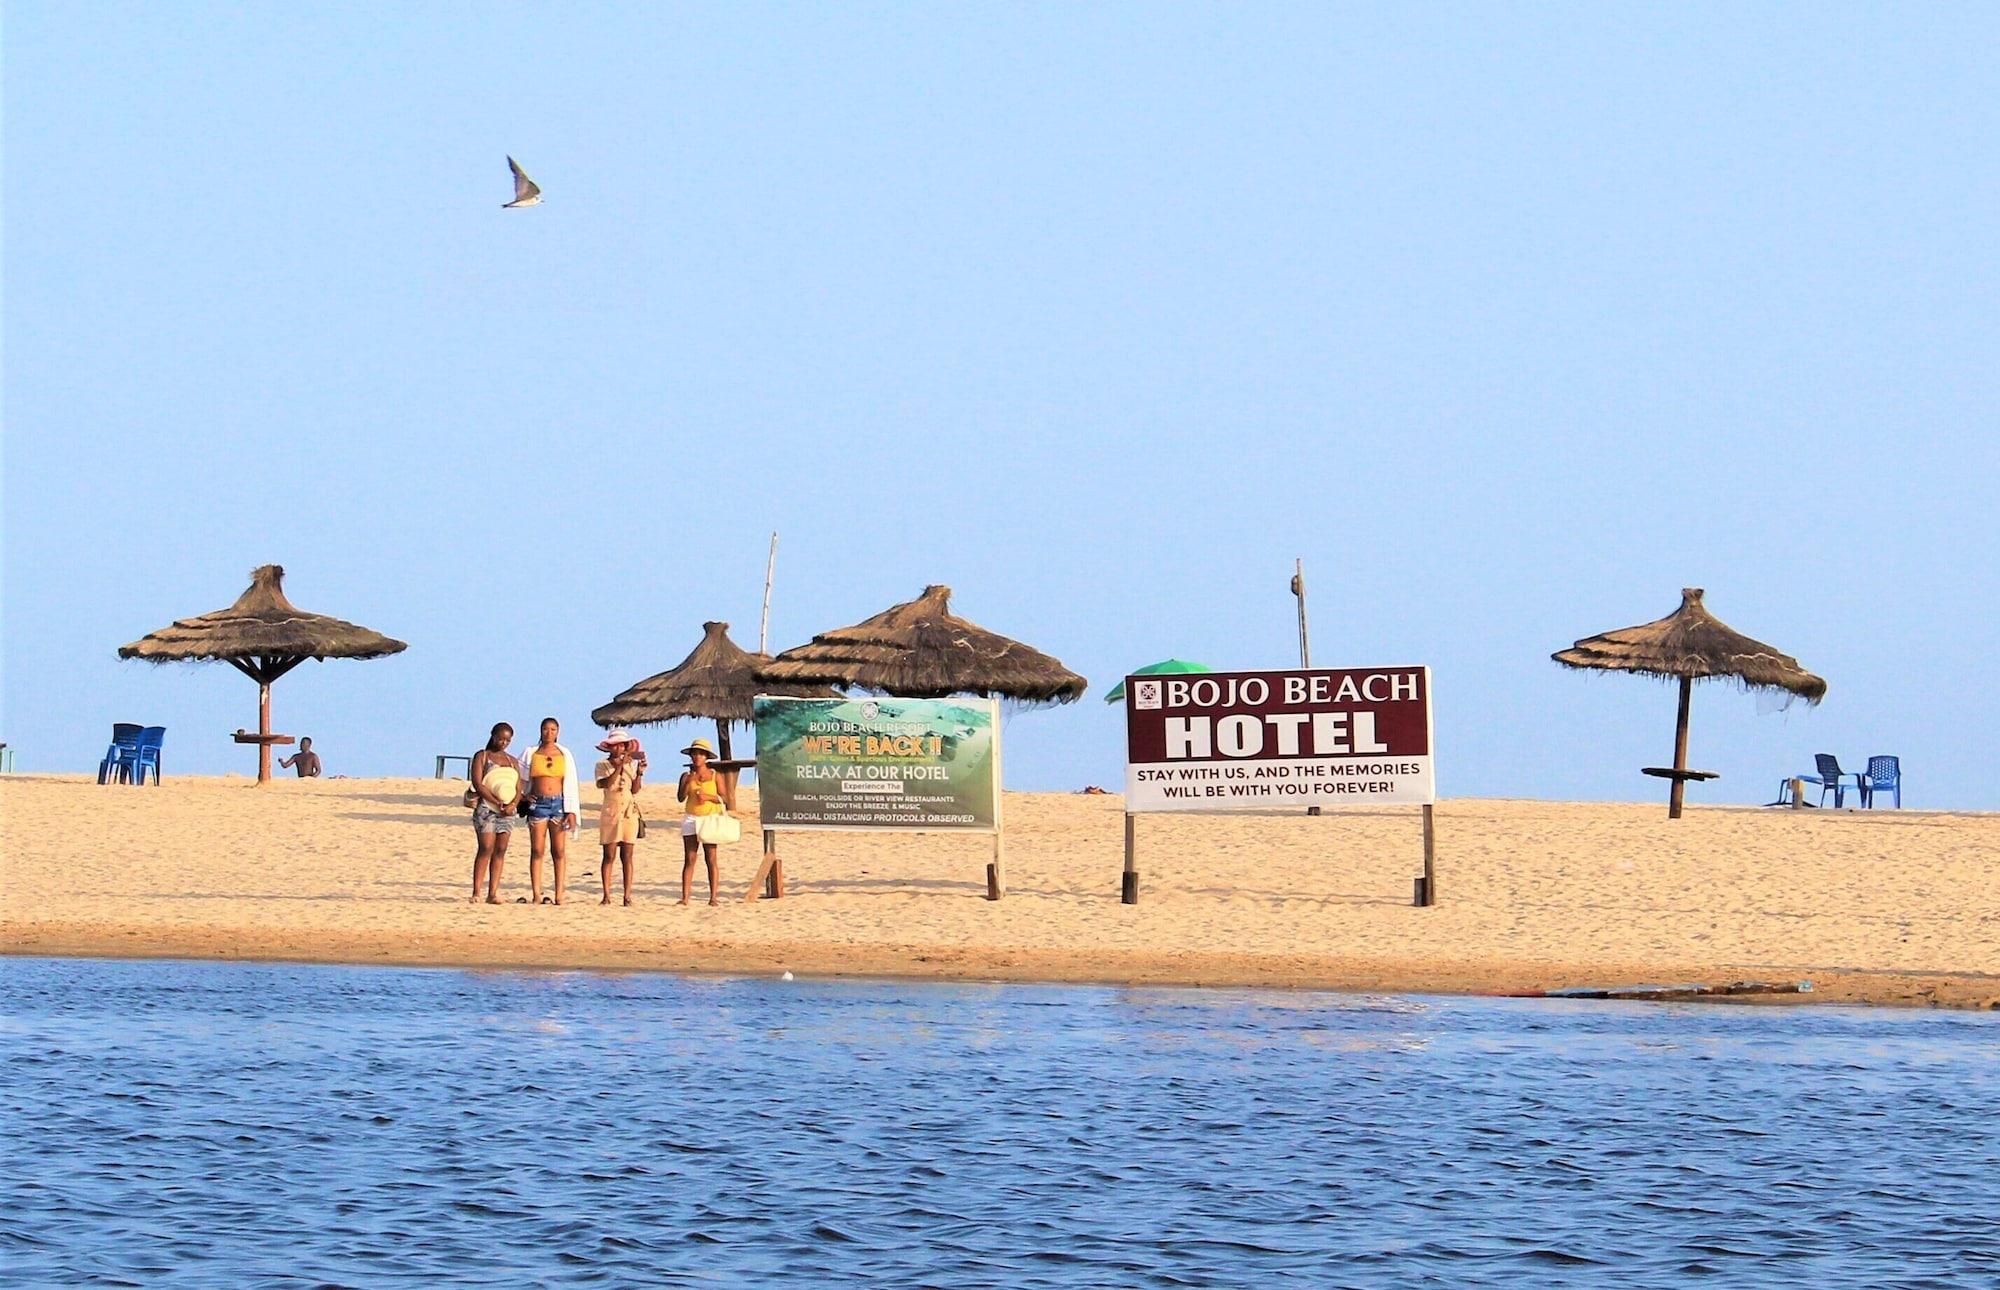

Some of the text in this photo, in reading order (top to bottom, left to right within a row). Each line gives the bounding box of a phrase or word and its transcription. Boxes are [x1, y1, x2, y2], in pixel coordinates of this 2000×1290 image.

[1167, 673, 1419, 708] BOJO BEACH
[809, 722, 840, 733] BOJO
[843, 722, 882, 733] BEACH
[1165, 711, 1388, 759] HOTEL
[802, 735, 862, 756] WE'RE
[866, 735, 926, 757] BACK
[796, 765, 949, 780] RELAX AT OUR HOTEL
[1137, 763, 1421, 781] STAY WITH US, AND THE MEMORIES
[843, 782, 901, 791] Experience The
[1163, 781, 1395, 798] WILL BE WITH YOU FOREVER!
[863, 802, 889, 810] BREEZE
[904, 795, 955, 803] RESTAURANTS
[774, 812, 975, 823] ALL SOCIAL DISTANCING PROTOCOLS OBSERVED
